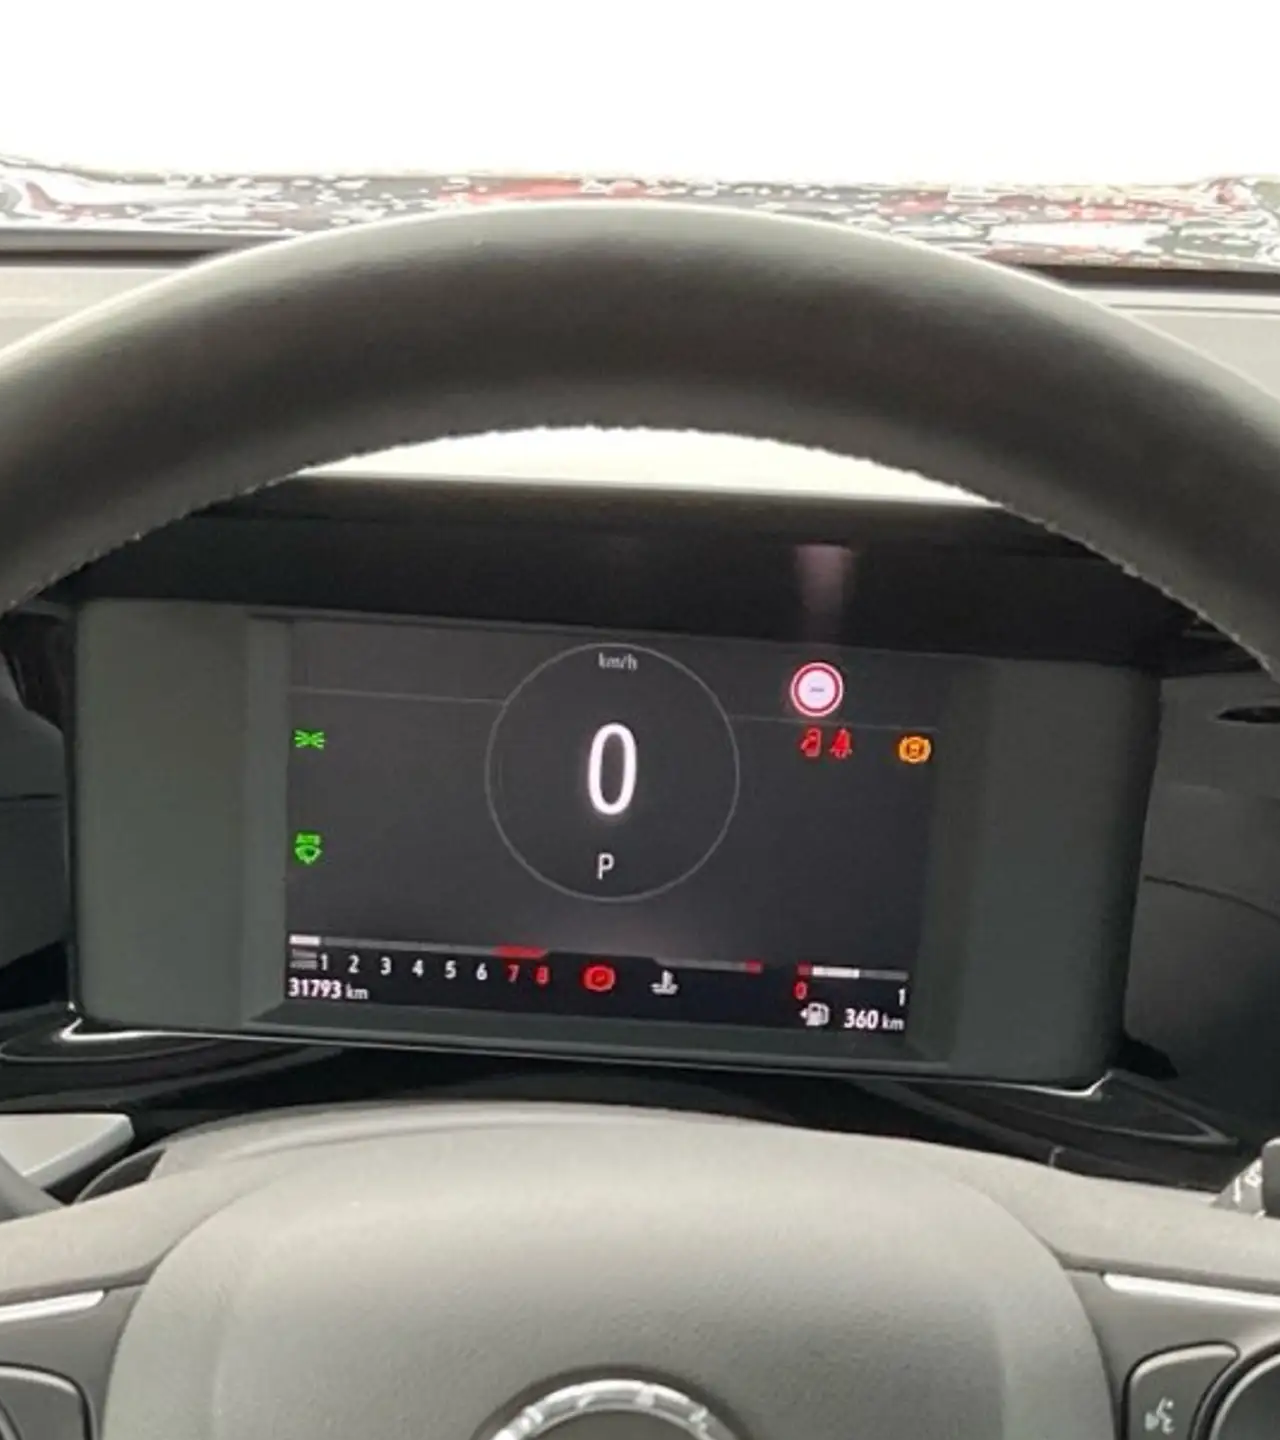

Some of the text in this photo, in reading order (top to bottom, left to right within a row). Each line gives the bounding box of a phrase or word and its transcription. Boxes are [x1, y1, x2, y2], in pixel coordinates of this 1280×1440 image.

[598, 652, 638, 671] km/h
[587, 723, 637, 816] 0
[596, 853, 615, 879] P
[319, 953, 329, 972] 1
[347, 953, 361, 974] 2
[379, 956, 393, 977] 3
[411, 959, 425, 978] 4
[444, 959, 458, 980] 5
[475, 963, 489, 982] 6
[506, 964, 521, 983] 7
[288, 977, 368, 1000] 31793 km
[794, 980, 907, 1007] 0 1
[843, 1007, 905, 1031] 360 km
